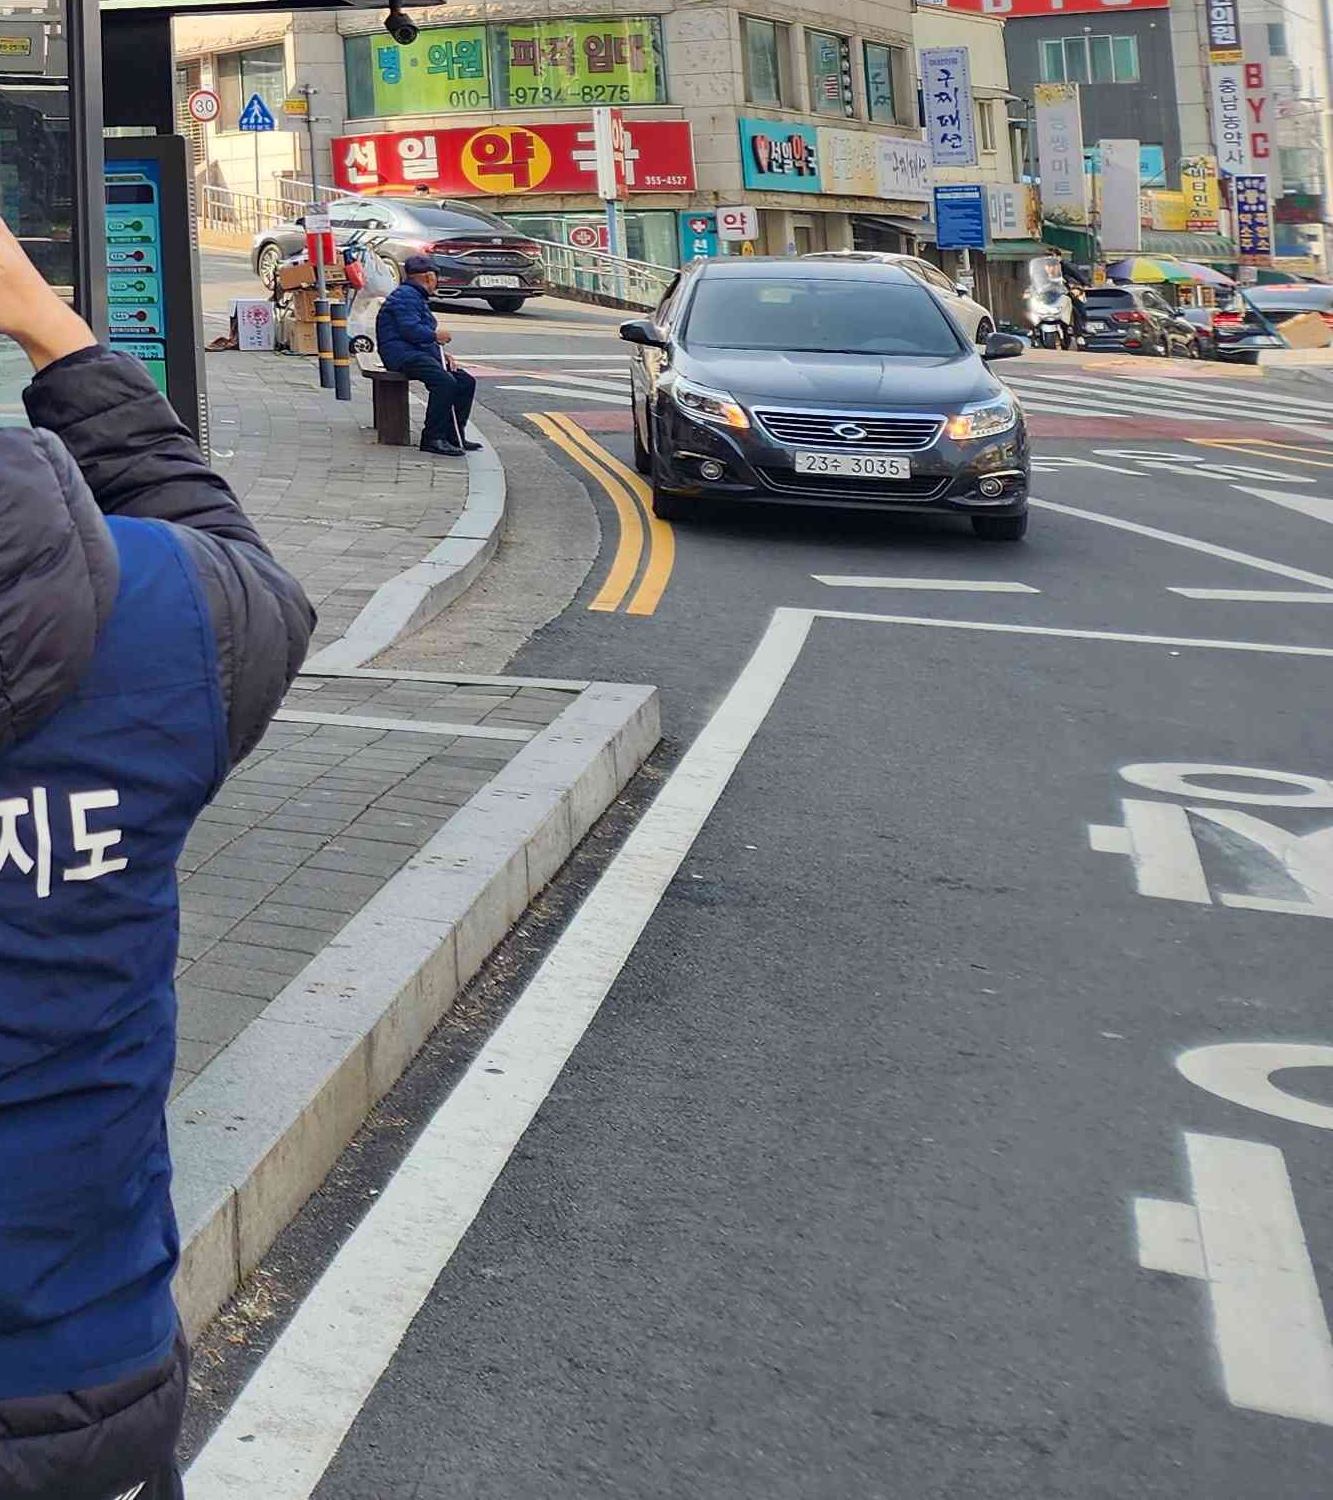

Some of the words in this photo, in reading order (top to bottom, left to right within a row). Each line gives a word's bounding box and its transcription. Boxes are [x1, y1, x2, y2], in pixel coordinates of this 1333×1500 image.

[584, 34, 648, 74] 임대
[195, 100, 214, 112] 30
[1245, 63, 1269, 158] BYC
[724, 212, 747, 235] 약
[806, 456, 842, 472] 23수
[851, 458, 901, 476] 3035
